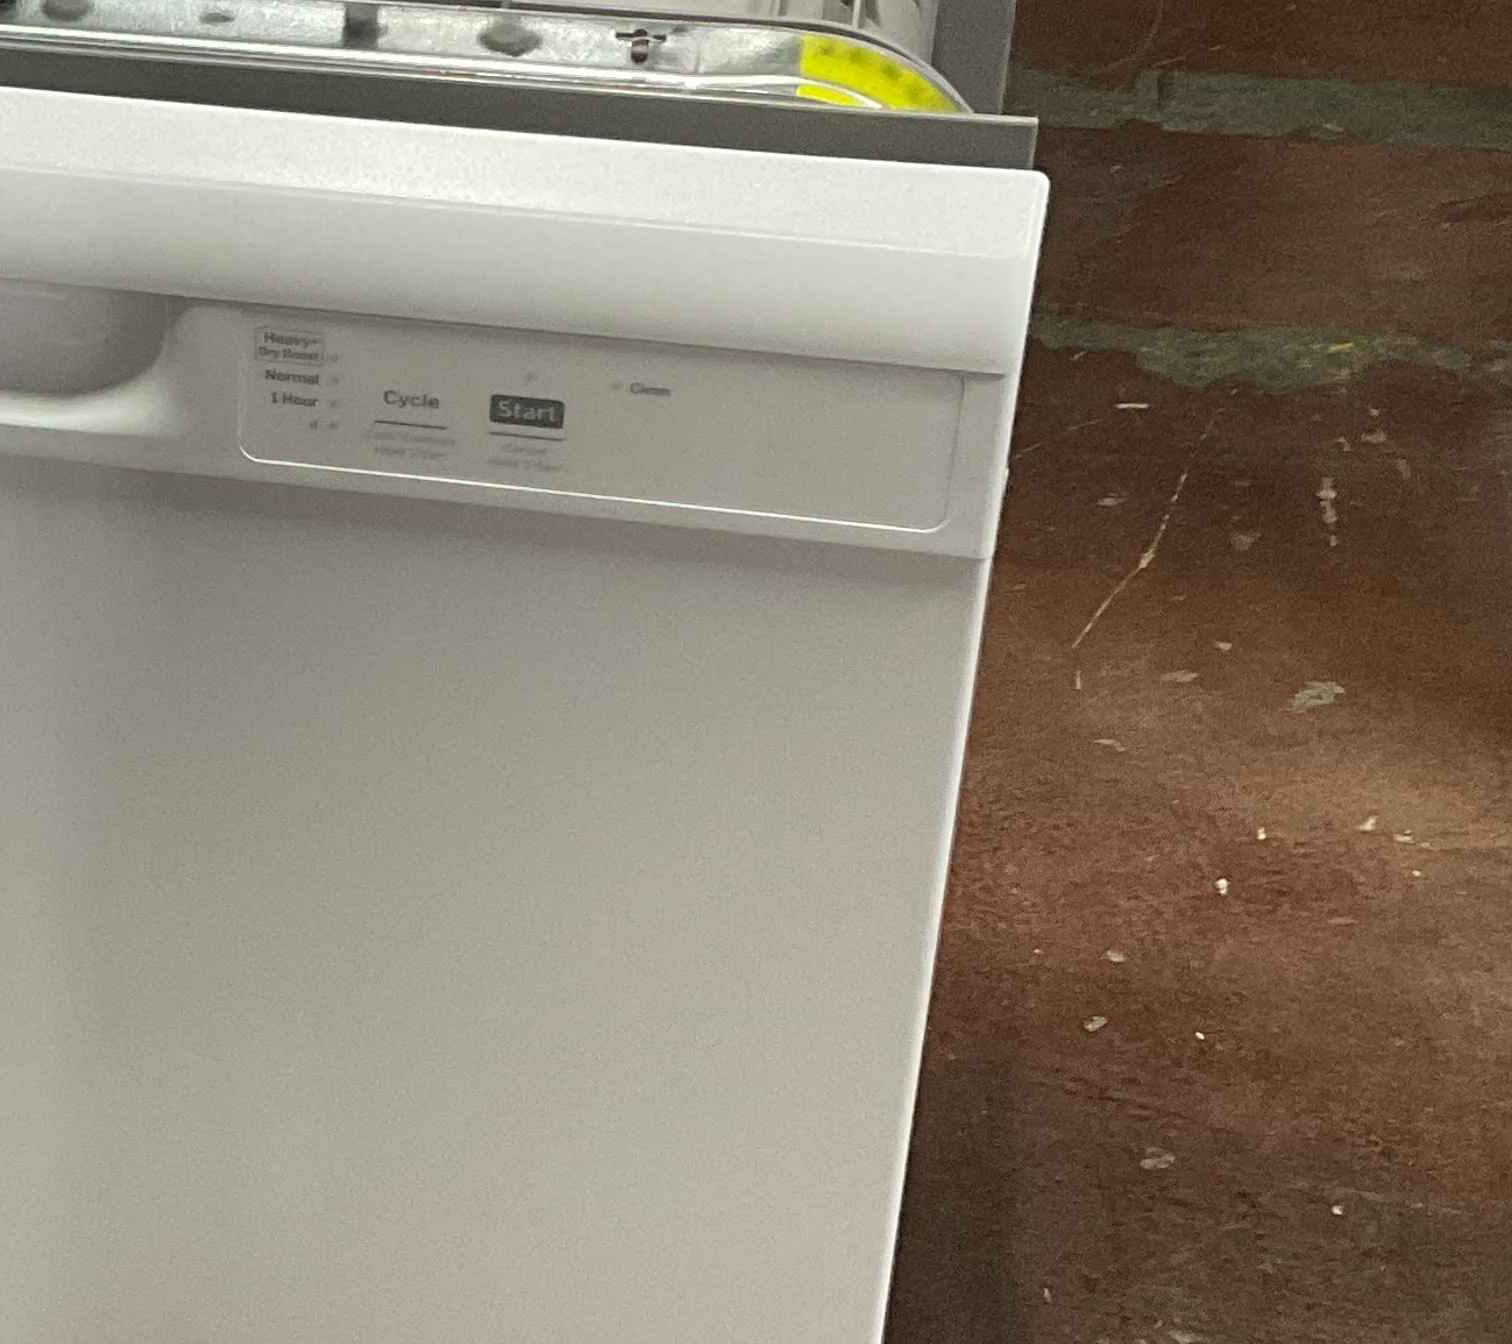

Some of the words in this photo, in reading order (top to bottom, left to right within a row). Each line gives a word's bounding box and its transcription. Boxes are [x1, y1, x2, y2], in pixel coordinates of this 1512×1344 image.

[264, 369, 320, 386] Normal
[281, 392, 319, 407] Hour
[382, 389, 441, 409] Cycle
[497, 400, 557, 423] Start
